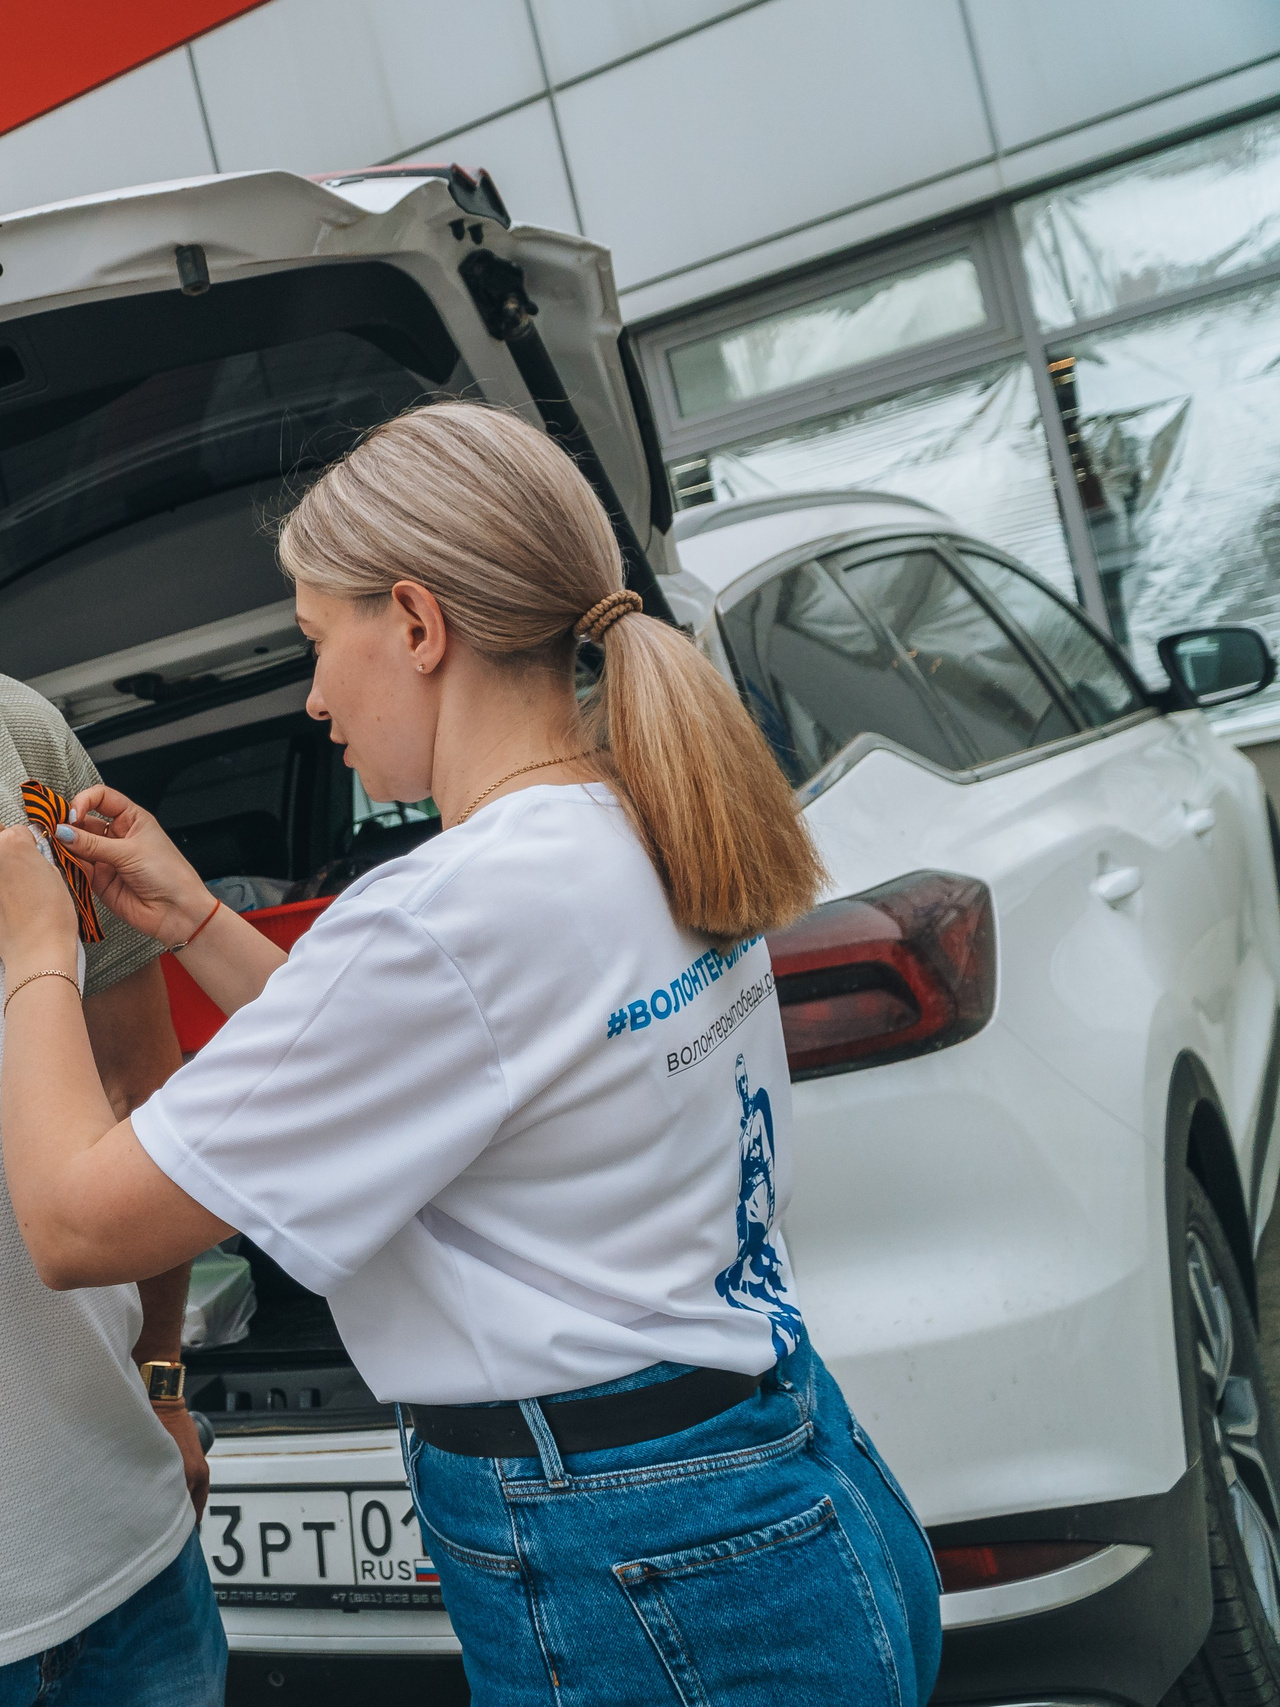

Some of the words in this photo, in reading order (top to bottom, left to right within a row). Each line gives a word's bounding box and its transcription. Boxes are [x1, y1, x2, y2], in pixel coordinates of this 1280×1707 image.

[209, 1505, 337, 1578] 3РТ
[361, 1560, 413, 1582] RUS
[331, 1592, 346, 1601] +7
[384, 1593, 410, 1604] 202
